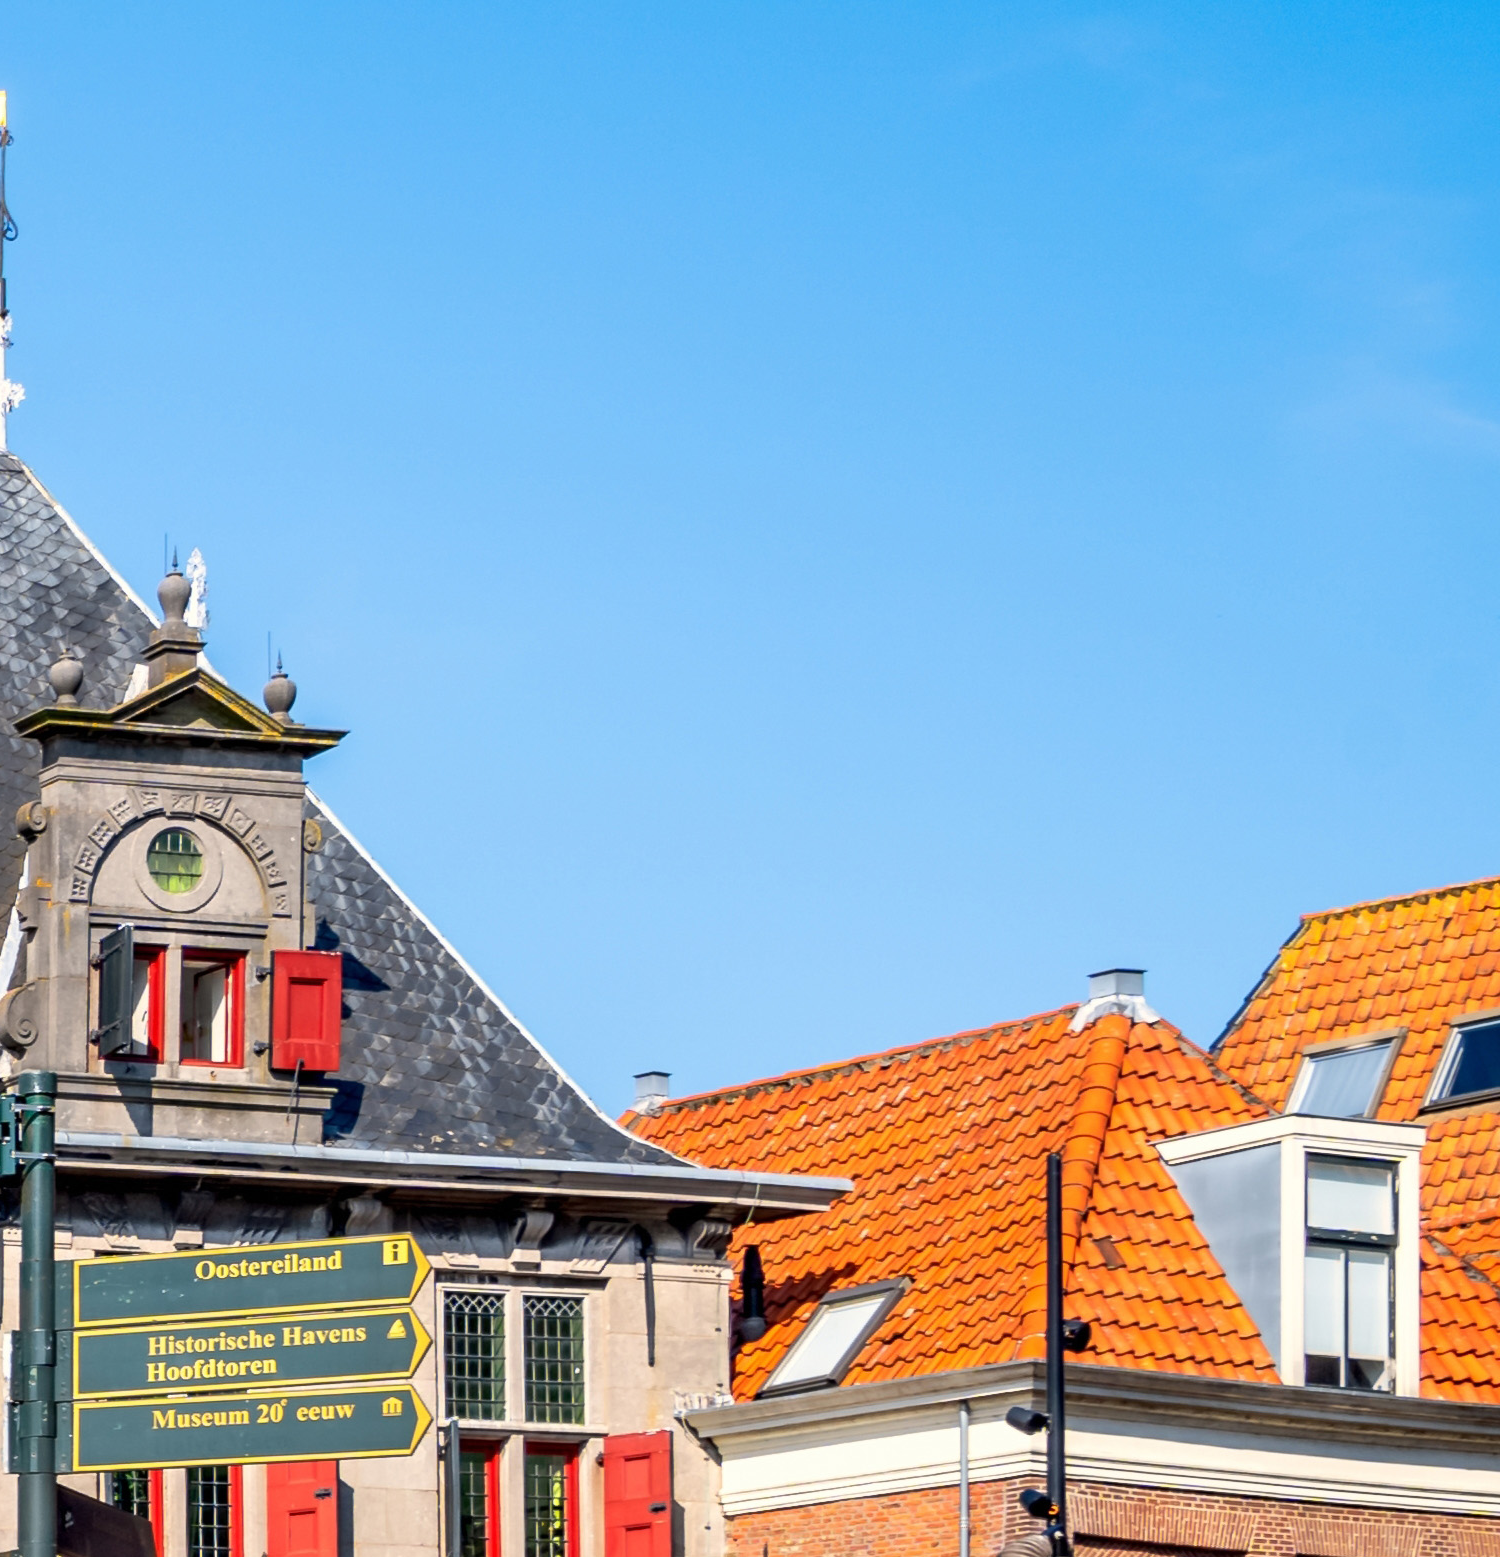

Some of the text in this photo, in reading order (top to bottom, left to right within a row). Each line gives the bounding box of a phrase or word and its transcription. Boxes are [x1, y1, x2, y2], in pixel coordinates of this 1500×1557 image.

[195, 1251, 343, 1280] Oostereiland
[147, 1325, 367, 1356] Historische Havens
[146, 1358, 277, 1383] Hoofdtoren
[152, 1408, 250, 1430] Museum
[296, 1403, 355, 1422] eeuw
